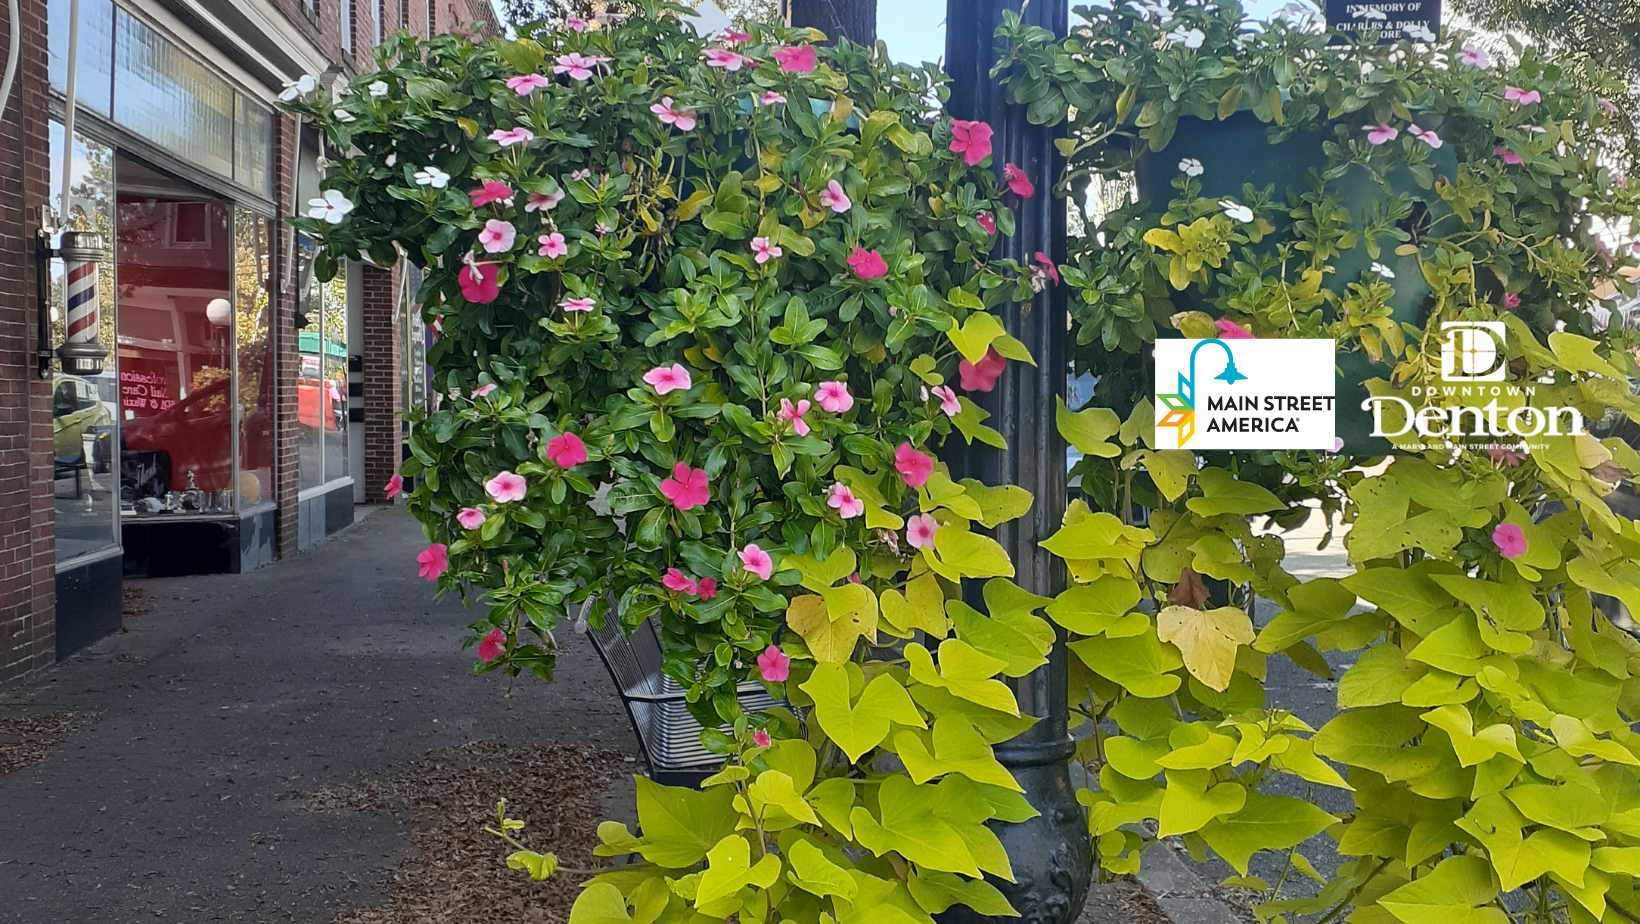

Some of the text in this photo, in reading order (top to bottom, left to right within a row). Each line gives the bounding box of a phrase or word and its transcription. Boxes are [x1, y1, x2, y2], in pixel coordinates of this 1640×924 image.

[1346, 4, 1357, 13] IN
[1407, 2, 1421, 12] OF
[1385, 21, 1393, 30] &
